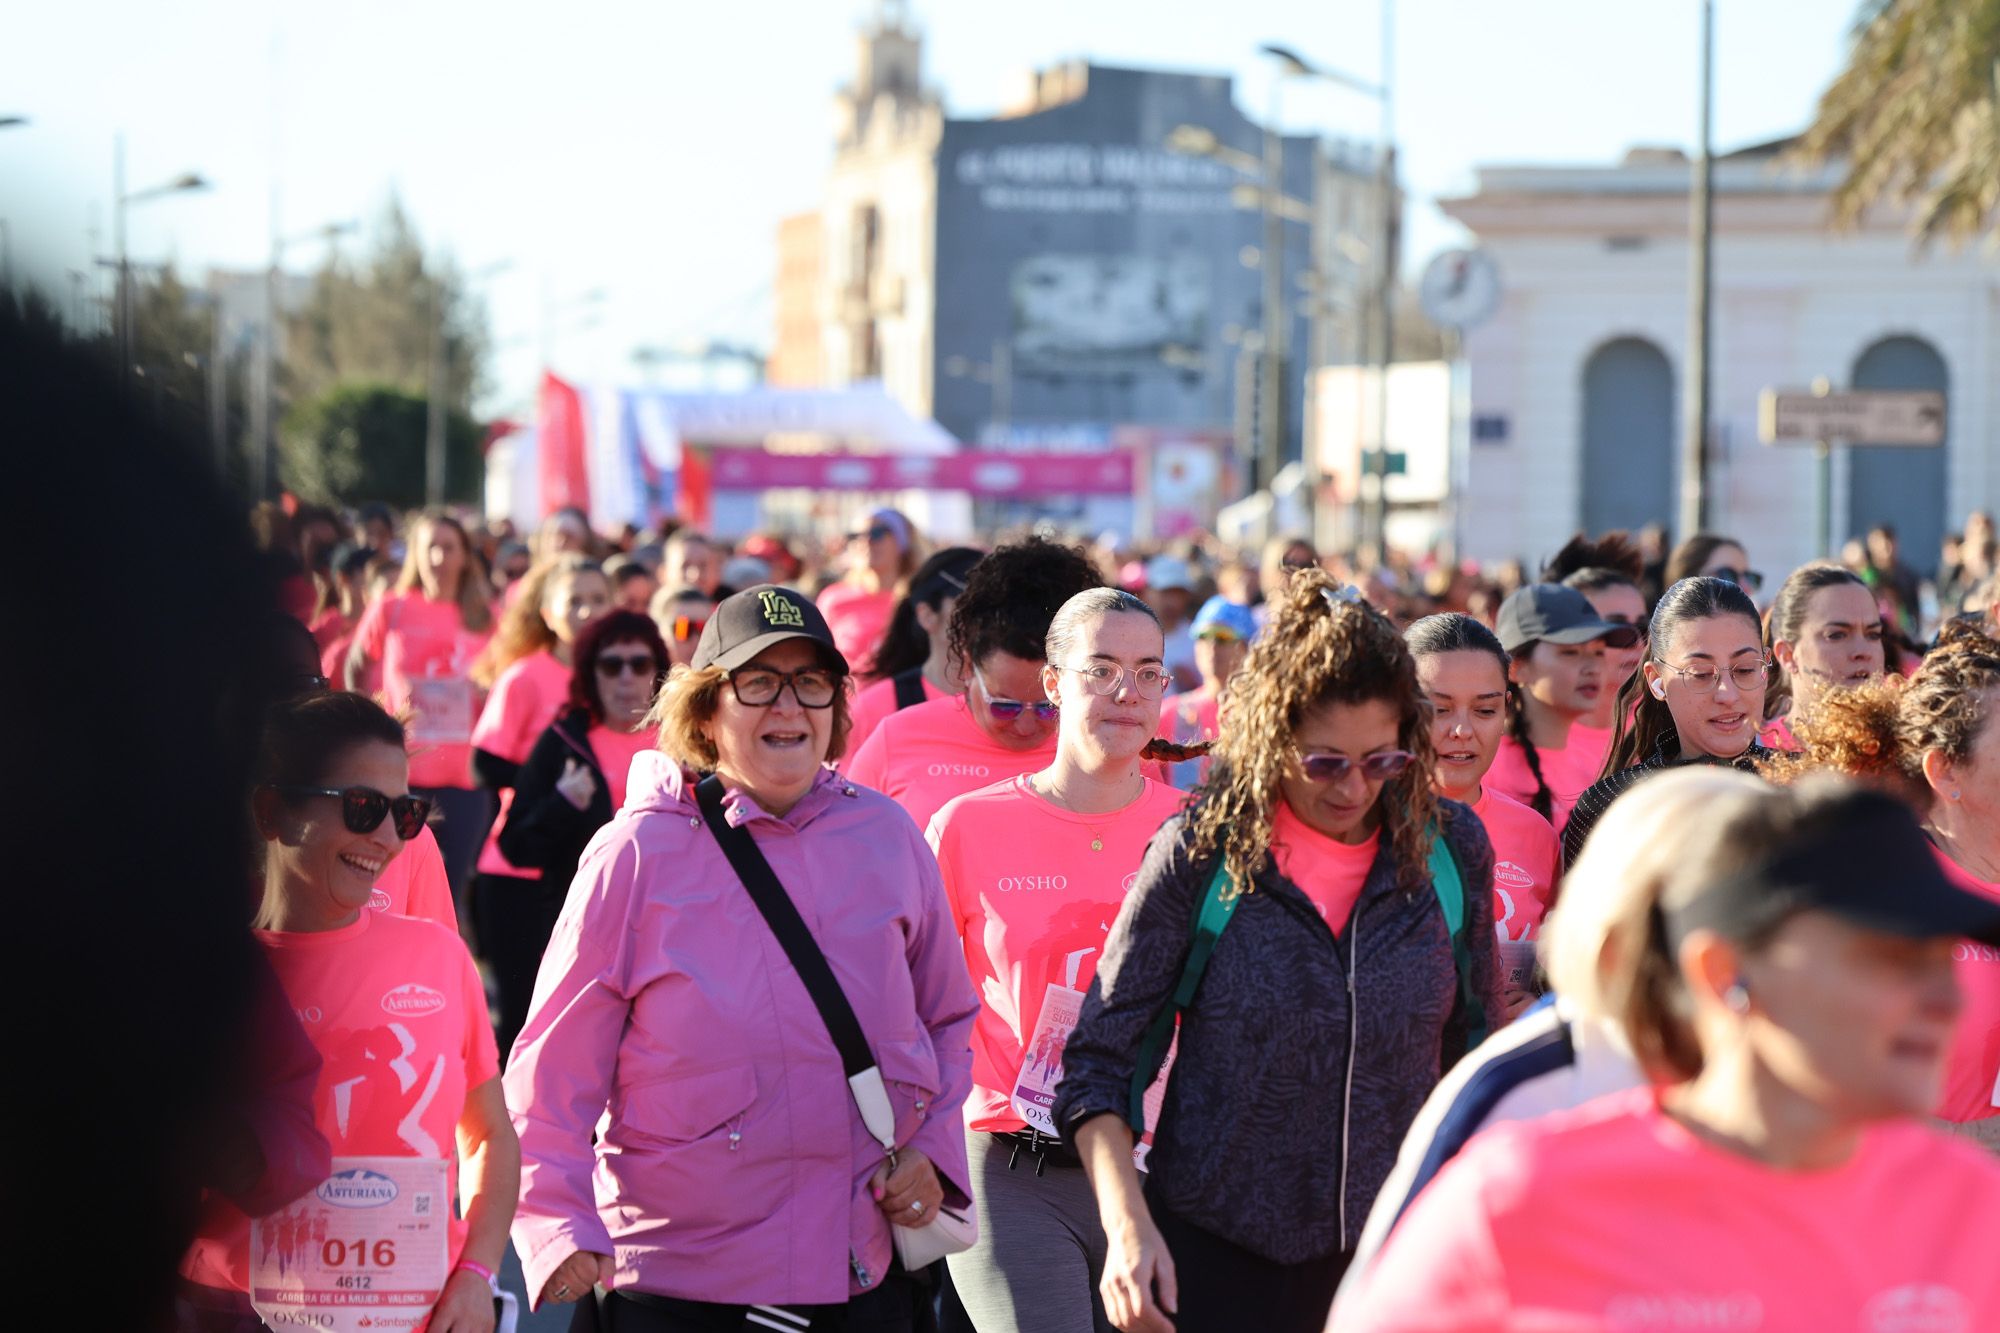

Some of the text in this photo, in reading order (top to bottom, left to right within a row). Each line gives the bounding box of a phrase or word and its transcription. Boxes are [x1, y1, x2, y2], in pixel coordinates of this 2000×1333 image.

[758, 591, 804, 626] LA
[928, 764, 990, 778] OYSHO
[998, 876, 1068, 892] OYSHO
[323, 1182, 392, 1199] ASTURIANA
[322, 1239, 396, 1267] 016
[336, 1276, 371, 1289] 4612
[276, 1292, 318, 1304] CARRERA
[320, 1294, 332, 1304] DE
[335, 1294, 346, 1304] LA
[274, 1311, 335, 1327] OYSHO
